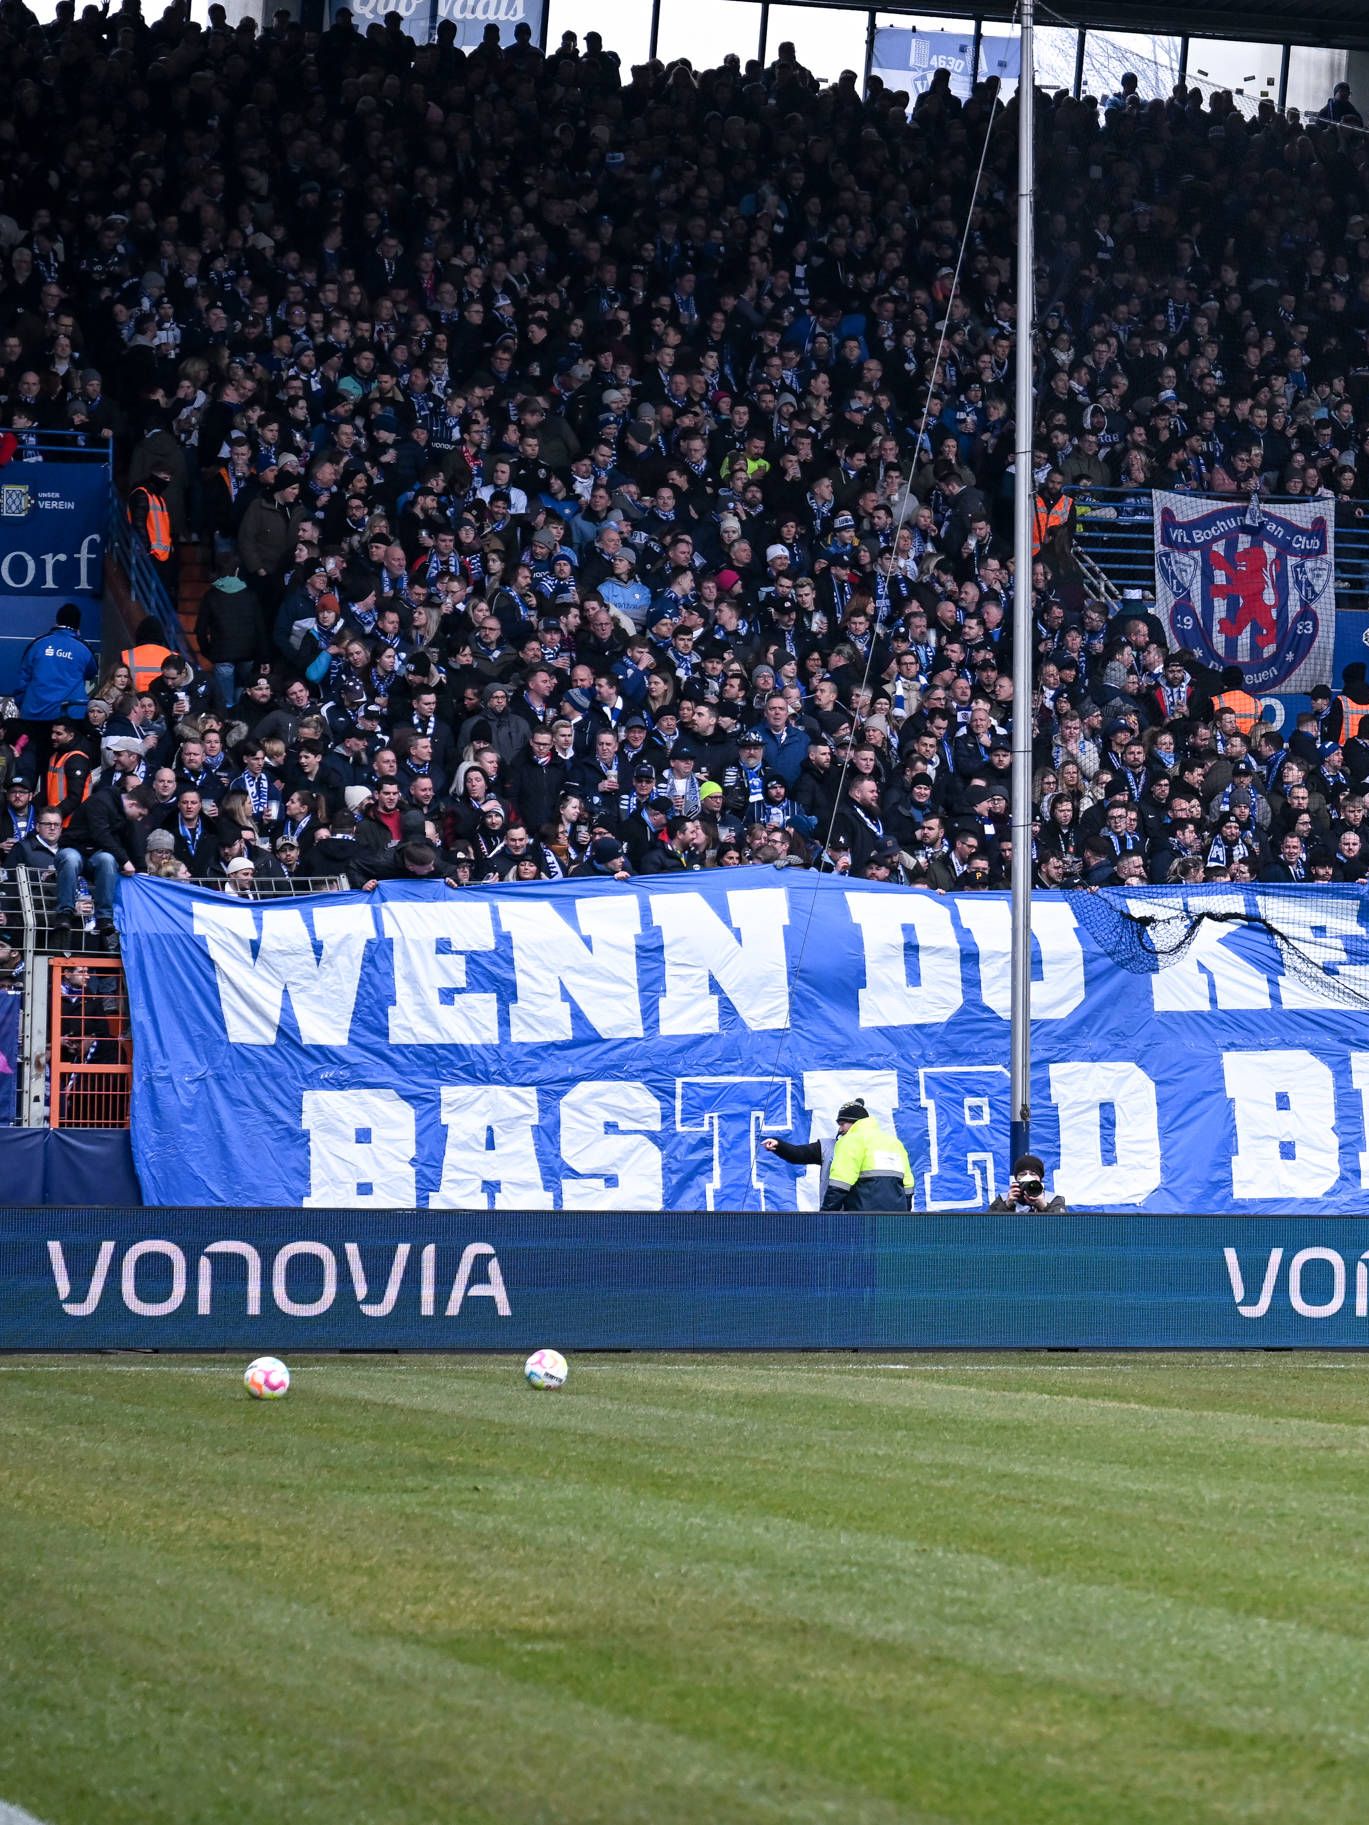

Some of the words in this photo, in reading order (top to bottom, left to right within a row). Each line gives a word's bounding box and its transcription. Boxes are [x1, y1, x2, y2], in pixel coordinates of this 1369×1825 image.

[930, 54, 965, 73] 4630
[37, 500, 75, 510] VEREIN
[1169, 527, 1191, 544] VfL
[1291, 534, 1321, 550] Club
[0, 533, 101, 590] orf
[1176, 615, 1194, 630] 19
[1296, 620, 1314, 634] 83
[56, 648, 73, 661] Gut.
[192, 887, 790, 1046] WENN
[845, 891, 1086, 1028] DU
[301, 1061, 1162, 1212] BASTARD
[46, 1238, 512, 1317] VONOVIA
